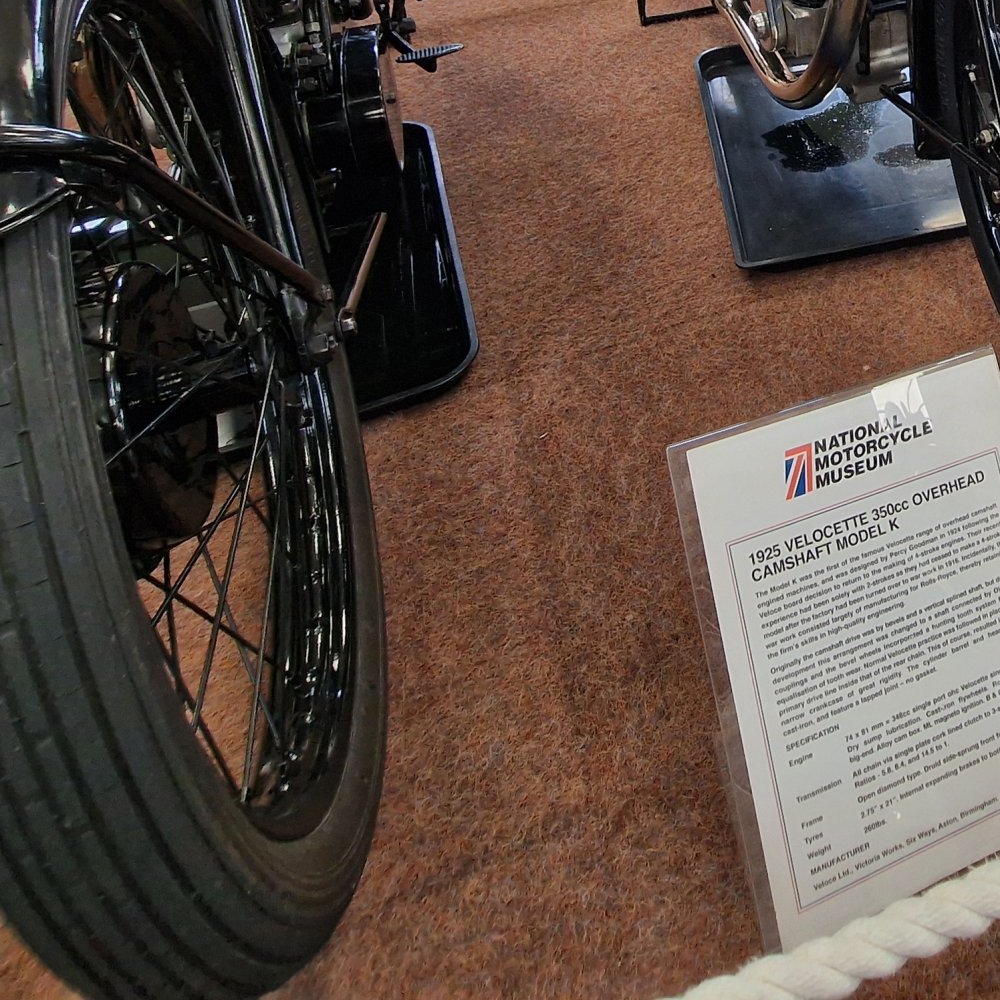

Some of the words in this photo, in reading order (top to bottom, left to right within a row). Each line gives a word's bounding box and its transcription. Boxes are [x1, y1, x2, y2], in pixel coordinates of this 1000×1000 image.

[813, 414, 903, 453] NATIONAL
[814, 419, 933, 472] MOTORCYCLE
[815, 450, 894, 490] MUSEUM
[748, 543, 780, 565] 1925
[784, 512, 868, 551] VELOCETTE
[871, 500, 909, 520] 350cc
[912, 470, 984, 505] OVERHEAD
[751, 541, 831, 581] CAMSHAFT
[835, 523, 886, 550] MODEL
[888, 516, 899, 531] K
[810, 841, 869, 875] MANUFACTURER
